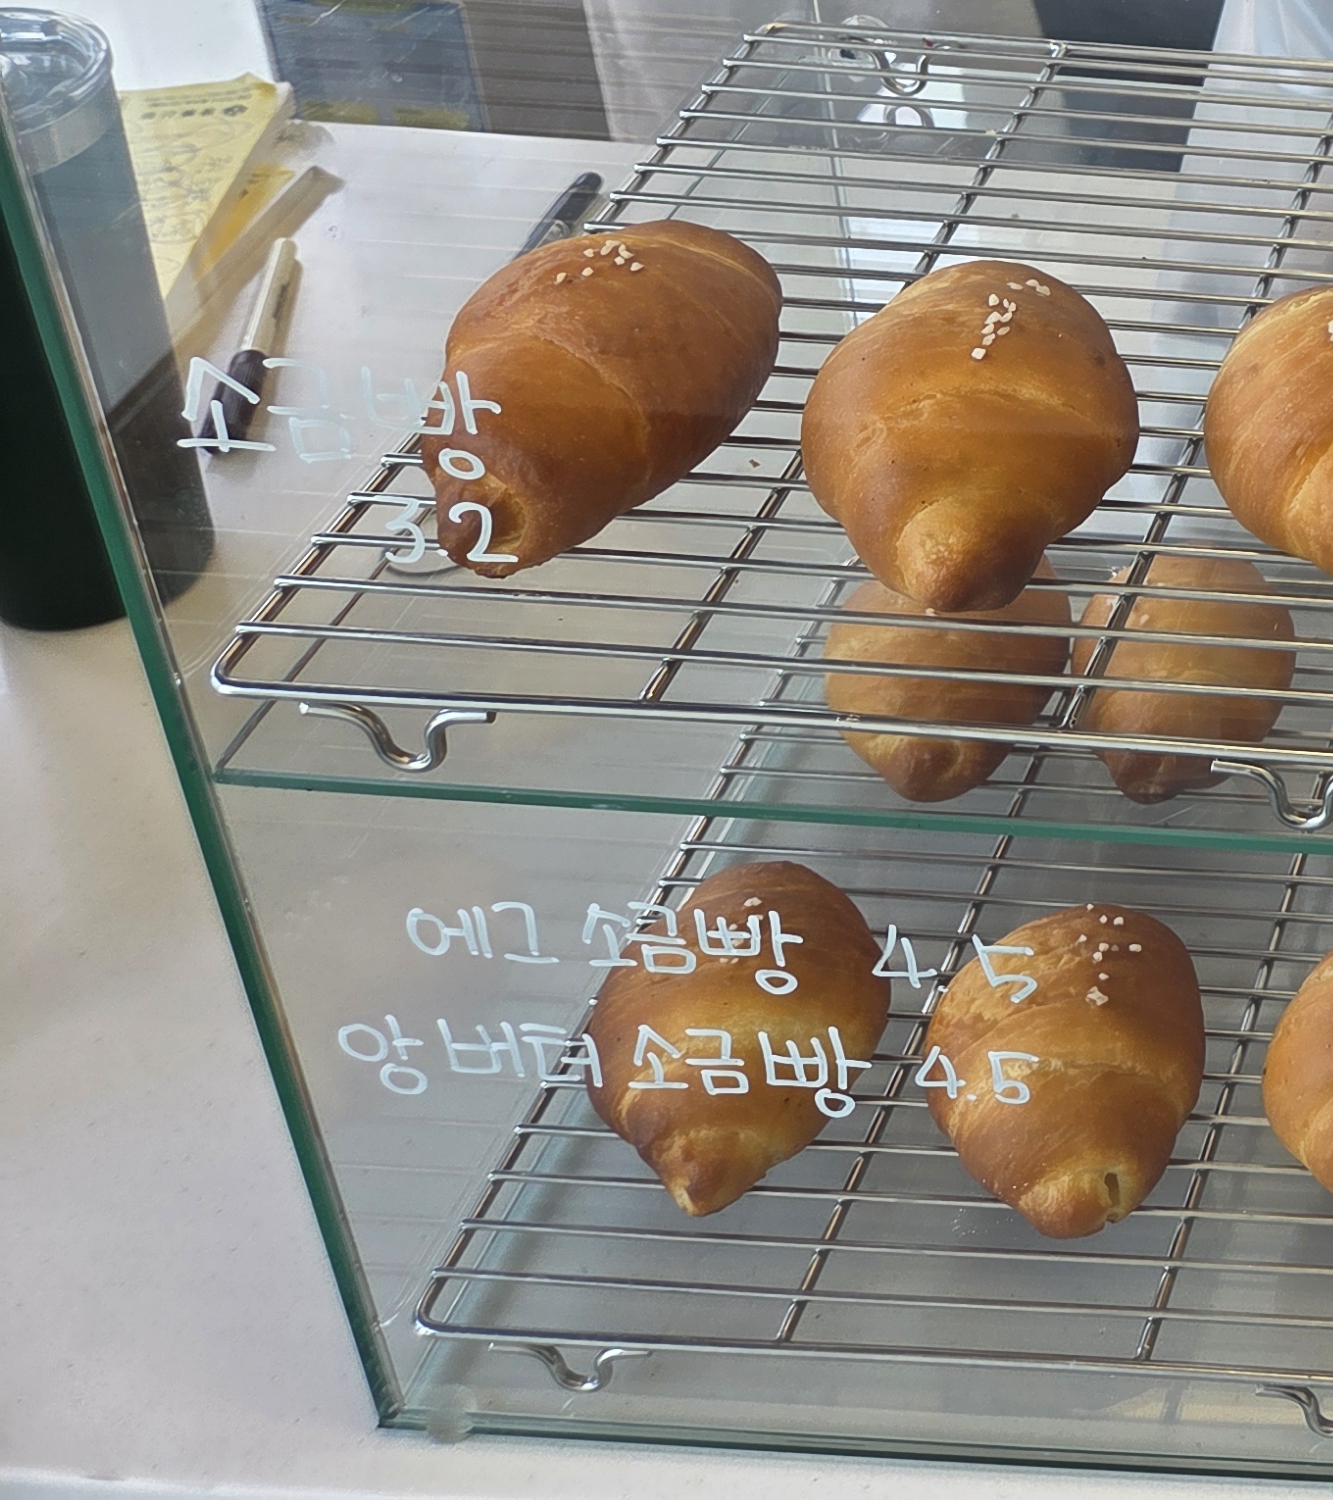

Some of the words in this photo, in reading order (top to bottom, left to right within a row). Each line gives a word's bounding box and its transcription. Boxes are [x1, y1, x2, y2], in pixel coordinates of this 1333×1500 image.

[406, 901, 559, 965] 에그
[581, 902, 804, 996] 소금빵
[872, 924, 1038, 1004] 4.5
[628, 1024, 873, 1119] 소금빵
